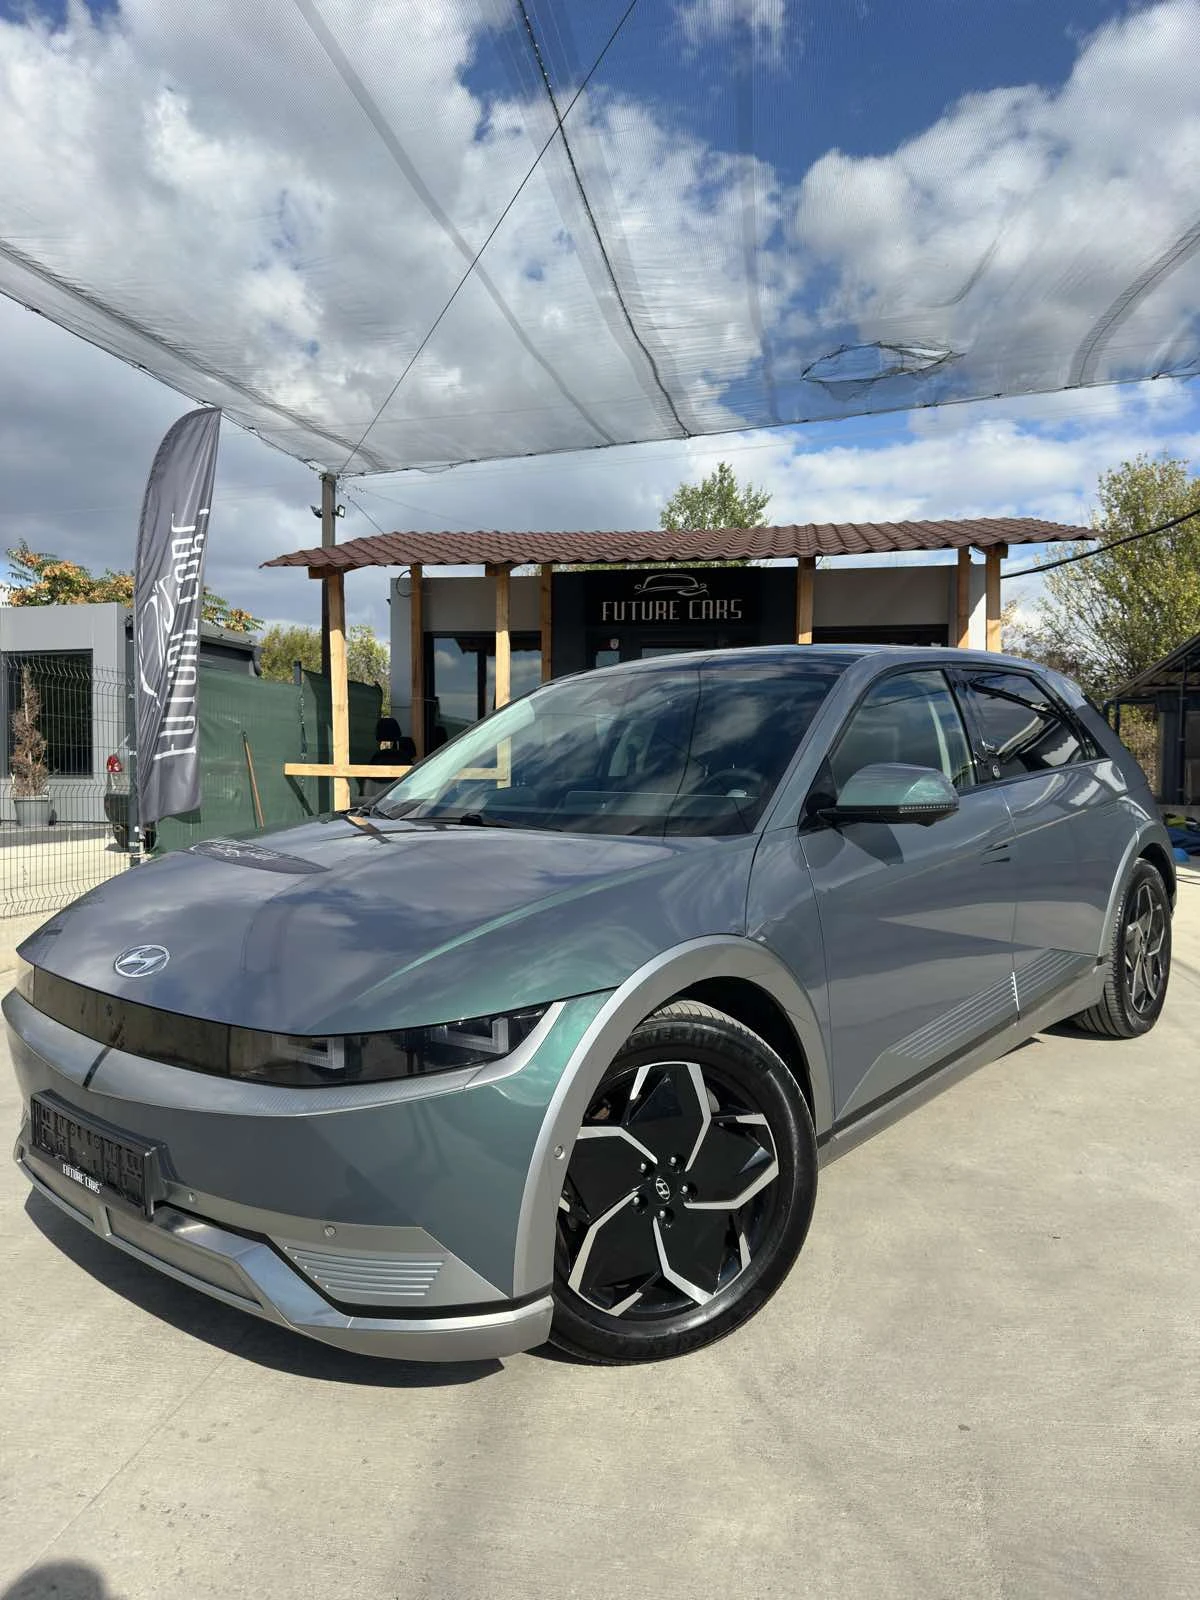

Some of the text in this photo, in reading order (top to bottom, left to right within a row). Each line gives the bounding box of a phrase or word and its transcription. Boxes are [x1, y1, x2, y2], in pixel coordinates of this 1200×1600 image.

[602, 599, 743, 621] FUTURE CARS
[62, 1163, 101, 1194] FUTURE CARS
